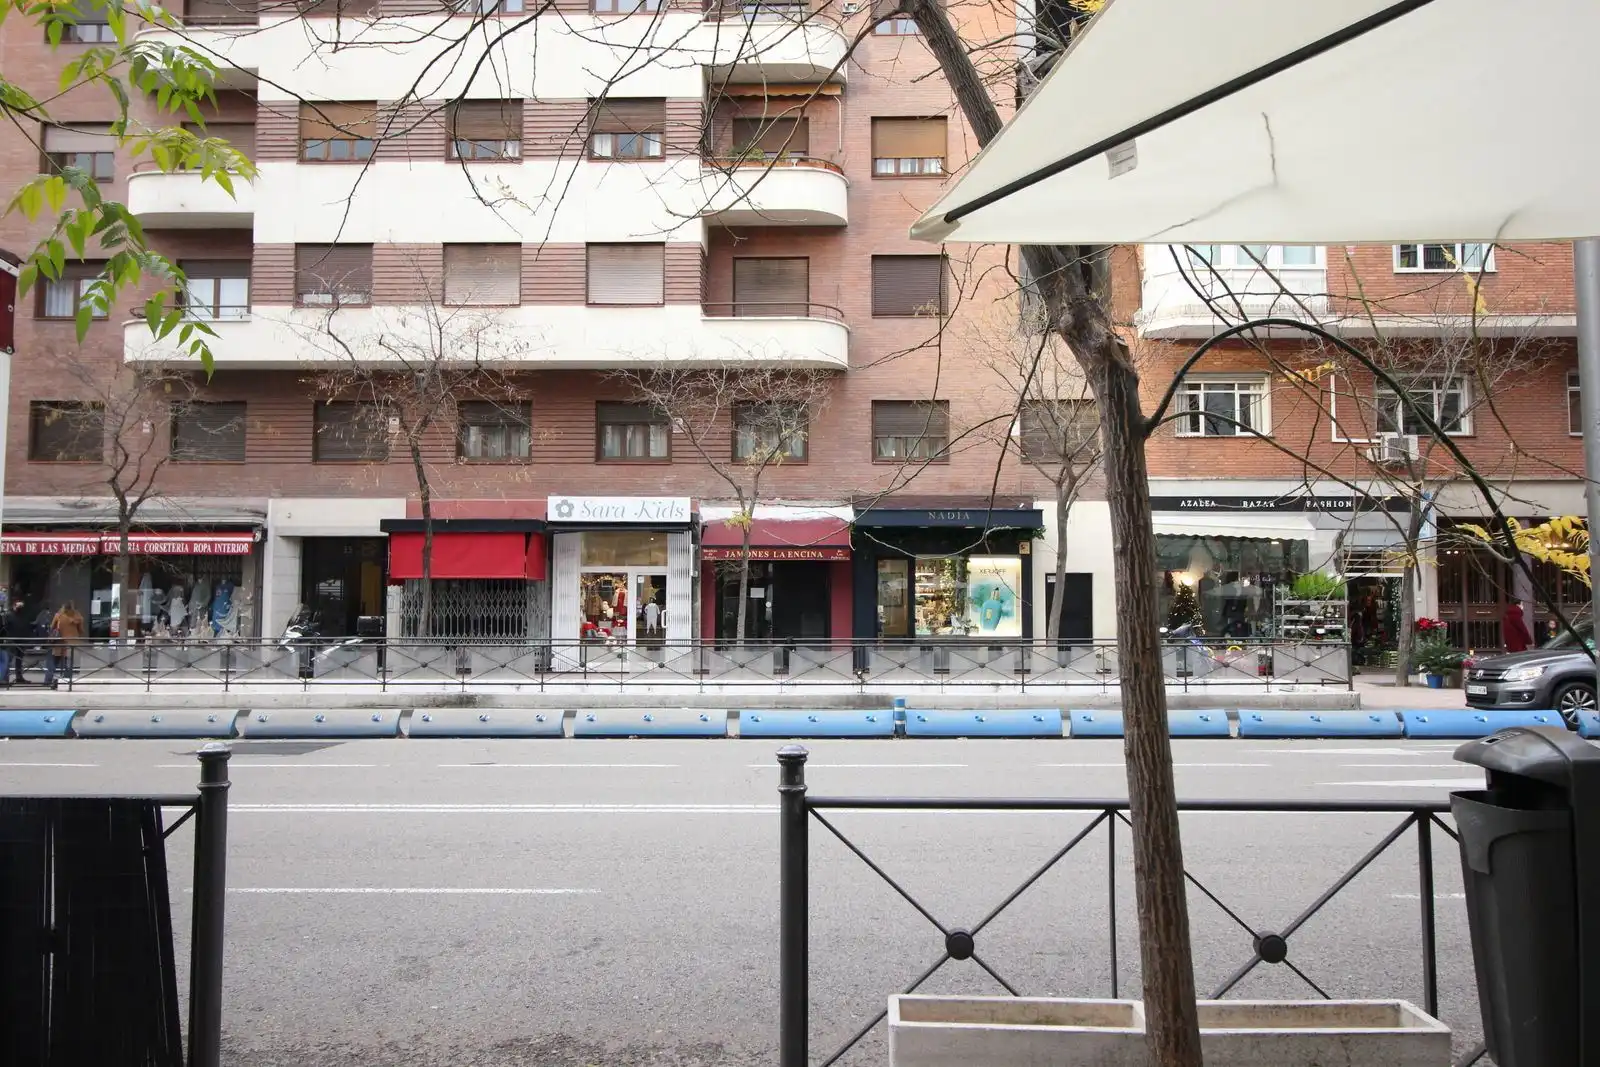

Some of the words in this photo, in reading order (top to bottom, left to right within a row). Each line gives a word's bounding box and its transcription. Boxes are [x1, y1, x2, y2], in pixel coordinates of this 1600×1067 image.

[1180, 499, 1216, 507] AZALEA
[1306, 499, 1352, 508] FASHION
[581, 500, 626, 518] Sara
[634, 499, 684, 519] Kids
[928, 511, 970, 520] NADIA
[25, 542, 37, 553] DE
[41, 542, 59, 553] LAS
[62, 542, 96, 553] MEDIAS
[104, 542, 140, 553] LENCRIA
[144, 542, 189, 553] CORSETERIA
[193, 542, 211, 553] ROPA
[214, 542, 249, 553] INTERIOR
[773, 550, 785, 558] LA
[787, 550, 824, 558] ENCINA
